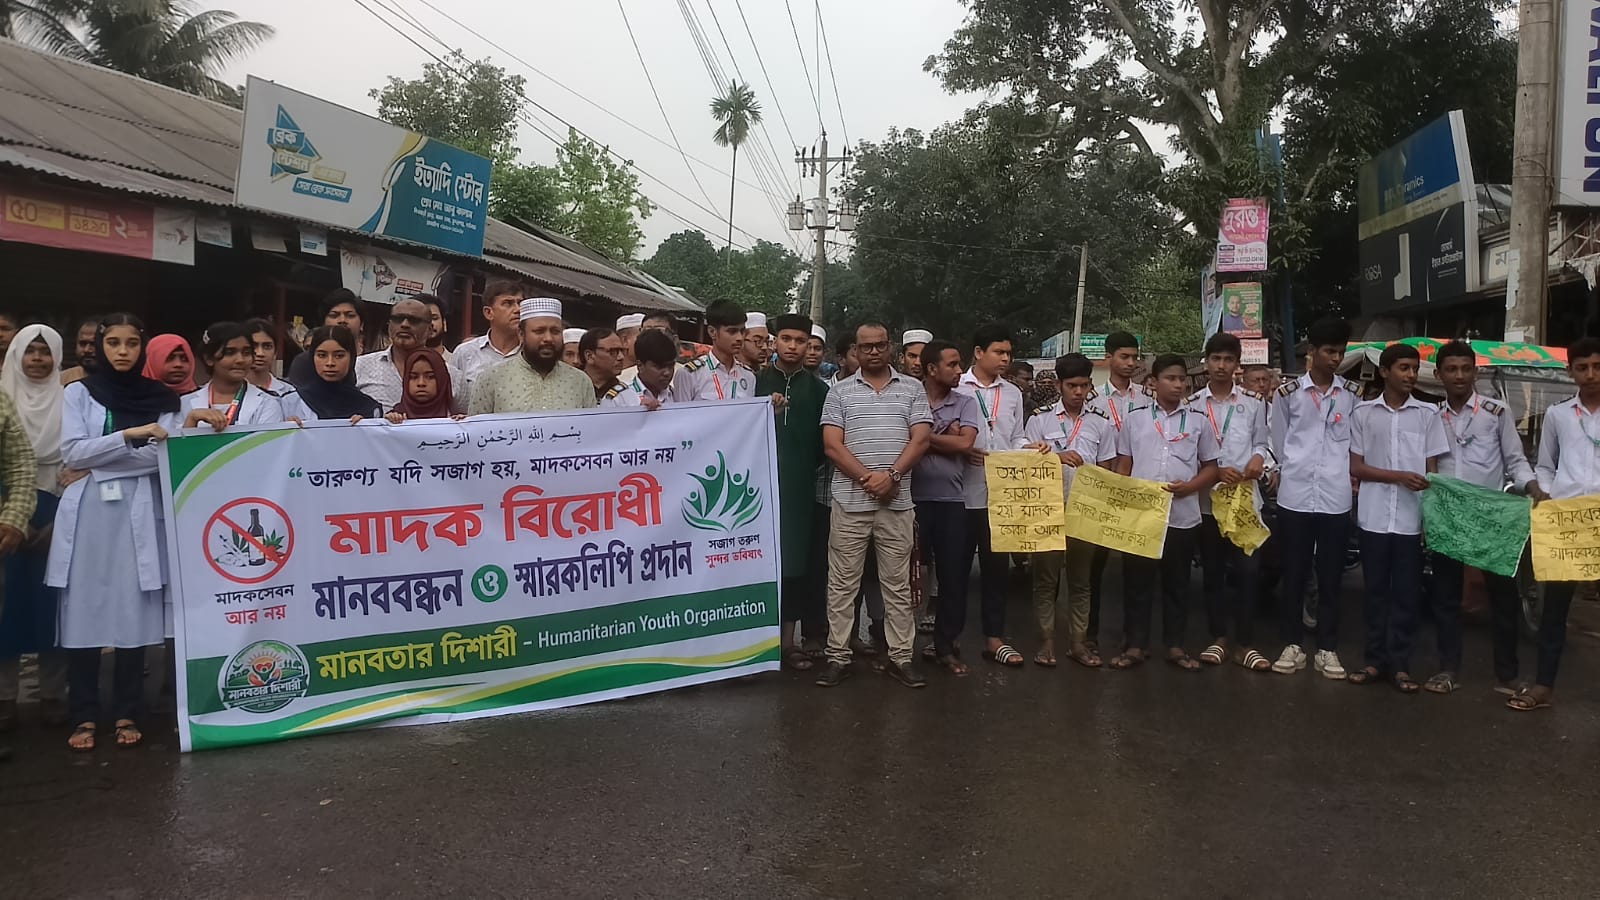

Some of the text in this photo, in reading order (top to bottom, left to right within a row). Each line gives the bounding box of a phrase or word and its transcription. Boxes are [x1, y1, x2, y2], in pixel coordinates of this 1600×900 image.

[414, 156, 484, 207] ইত্যাদি স্টোর
[389, 460, 424, 485] যদি
[430, 460, 485, 481] সজাগ
[491, 460, 520, 480] হয়,
[530, 451, 614, 475] মাদকসেবন
[619, 448, 650, 467] আর
[1031, 460, 1056, 480] যদি
[325, 472, 663, 555] মাদক বিরোধী
[708, 533, 760, 550] সজাগ তরুণ
[705, 552, 730, 569] সুন্দর
[215, 583, 295, 606] মাদকসেবন
[312, 540, 693, 620] মানববন্ধন ও স্মারকলিপি প্রদান
[225, 604, 287, 626] আর নয়
[316, 642, 434, 680] মানবতার
[440, 624, 518, 665] দিশারী
[538, 620, 636, 649] Humanitarian
[639, 611, 681, 632] Youth
[684, 599, 767, 625] Organization
